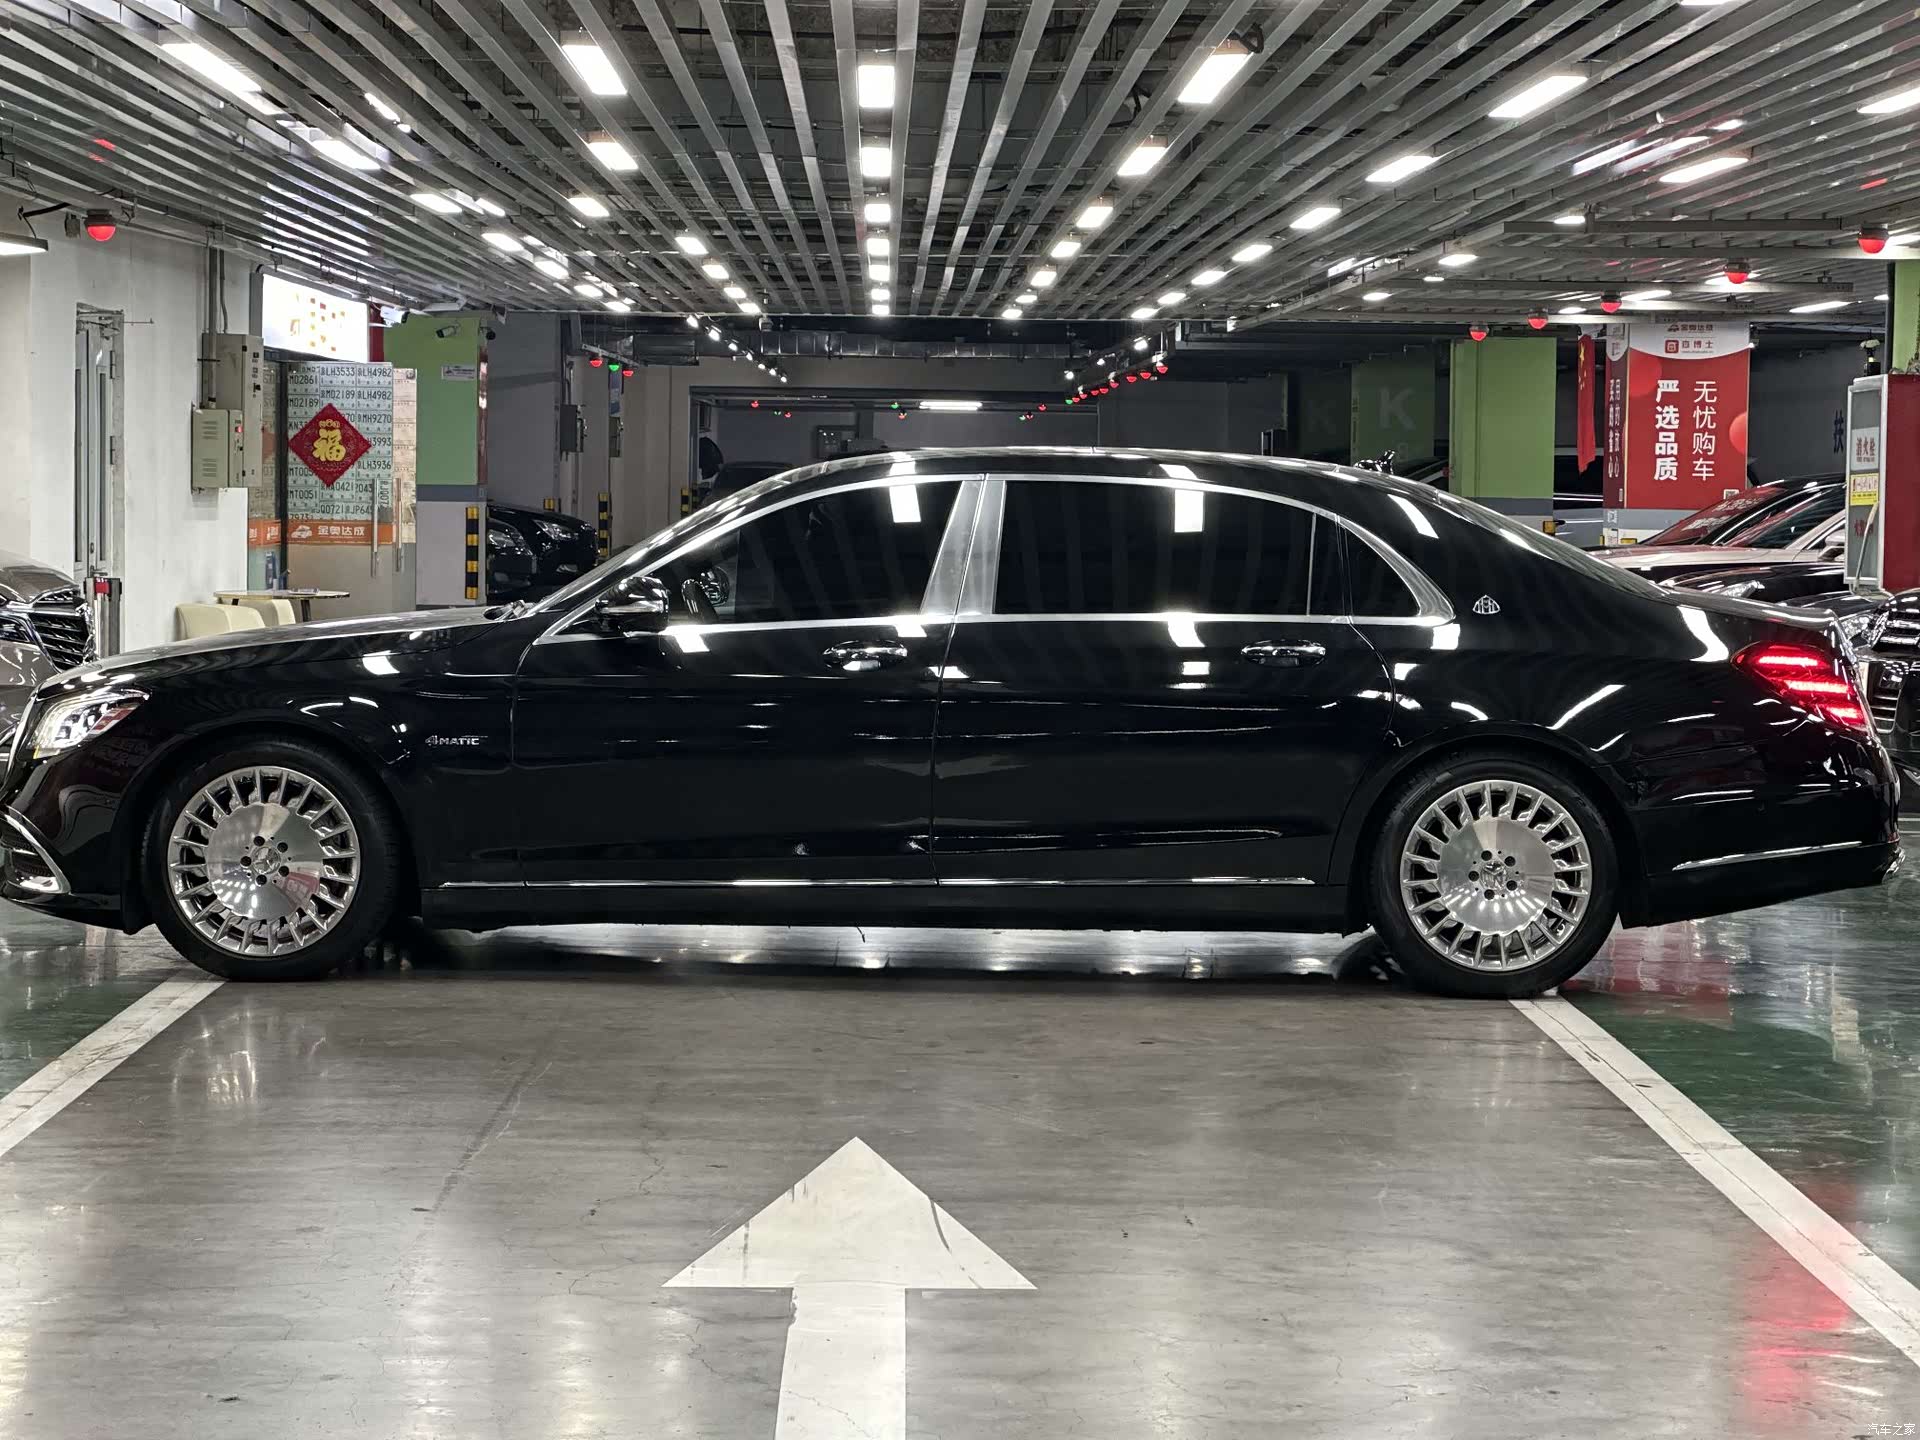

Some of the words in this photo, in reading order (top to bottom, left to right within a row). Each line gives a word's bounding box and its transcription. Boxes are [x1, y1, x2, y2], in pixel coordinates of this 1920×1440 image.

[1654, 380, 1680, 480] 严选品质
[1692, 381, 1717, 481] 无忧购车
[317, 525, 366, 536] 金奥达成
[424, 734, 480, 746] 4MATIC
